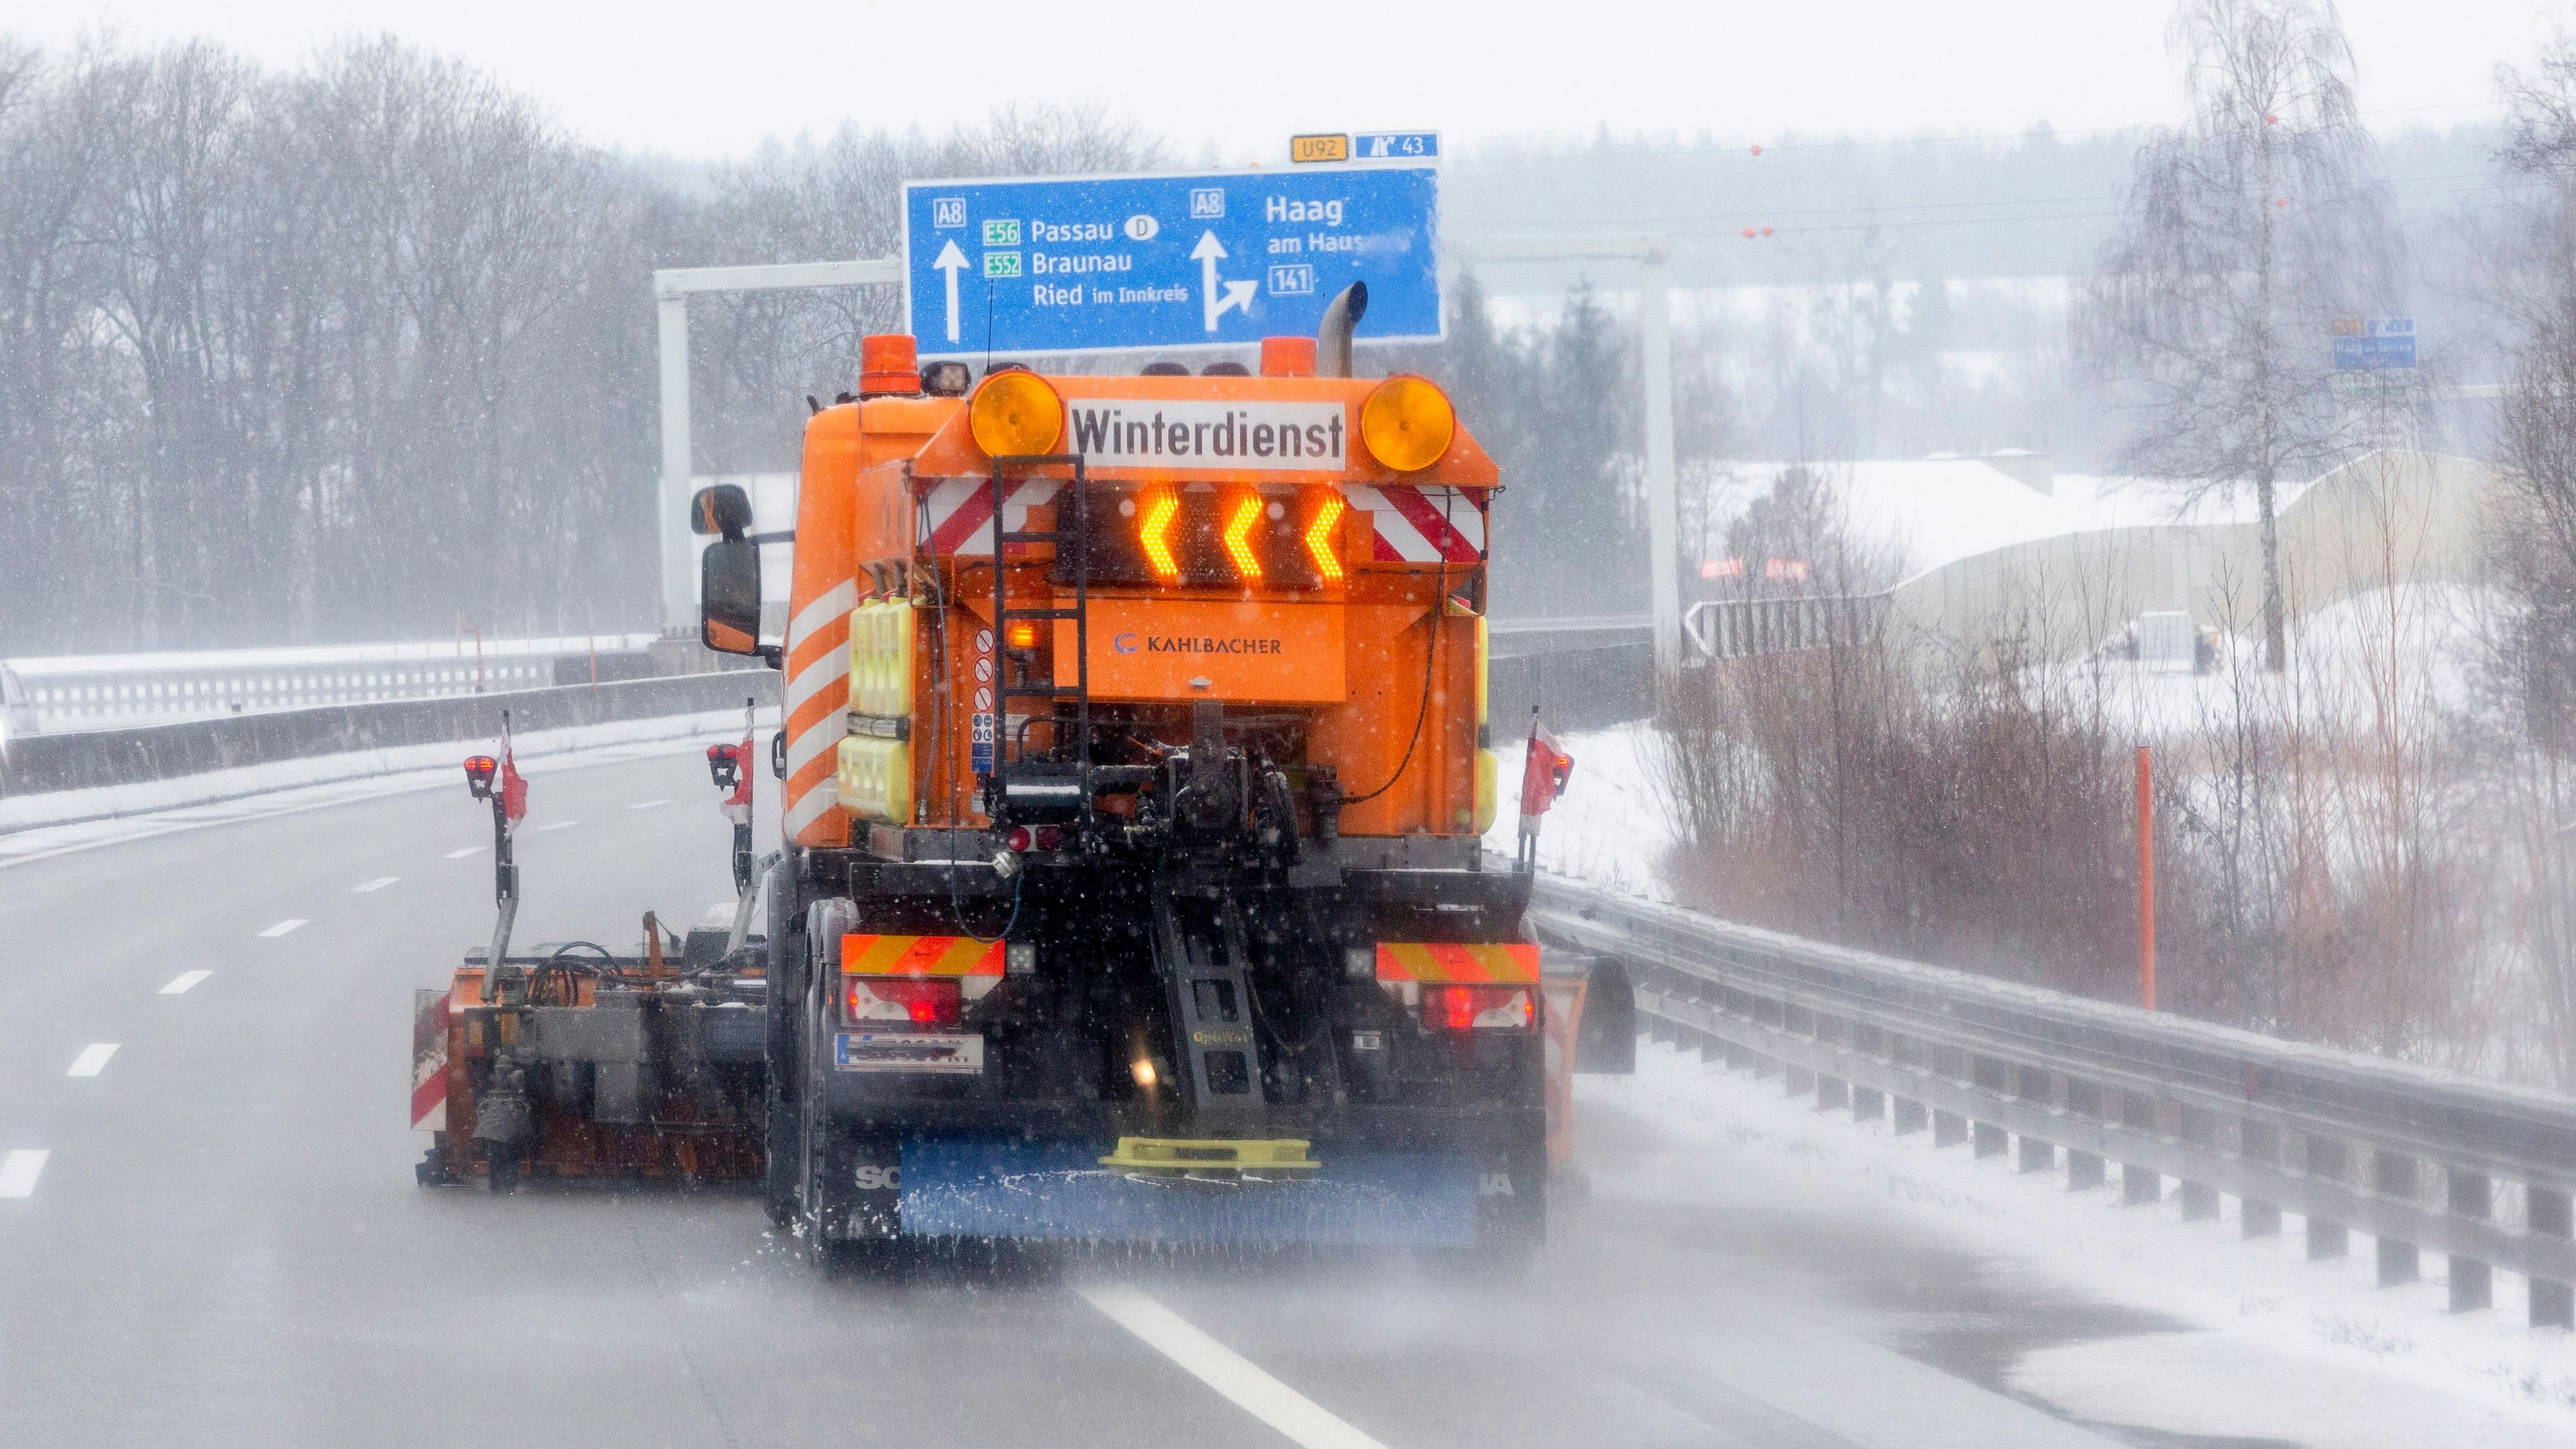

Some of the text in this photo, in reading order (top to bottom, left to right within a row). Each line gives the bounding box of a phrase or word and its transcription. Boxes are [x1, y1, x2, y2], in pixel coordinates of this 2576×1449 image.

[1302, 140, 1337, 157] U92
[1402, 137, 1424, 154] 43
[938, 201, 963, 225] A8
[1195, 193, 1220, 214] A8
[1266, 196, 1343, 226] Haag
[985, 219, 1149, 243] E56 Passau D
[1267, 232, 1397, 254] am Haus
[986, 252, 1132, 274] E552 Braunau
[1276, 269, 1307, 290] 141
[1034, 283, 1189, 306] Ried im Innkreis
[1071, 408, 1343, 458] Winterdienst
[1148, 636, 1282, 654] KAHLBACHER
